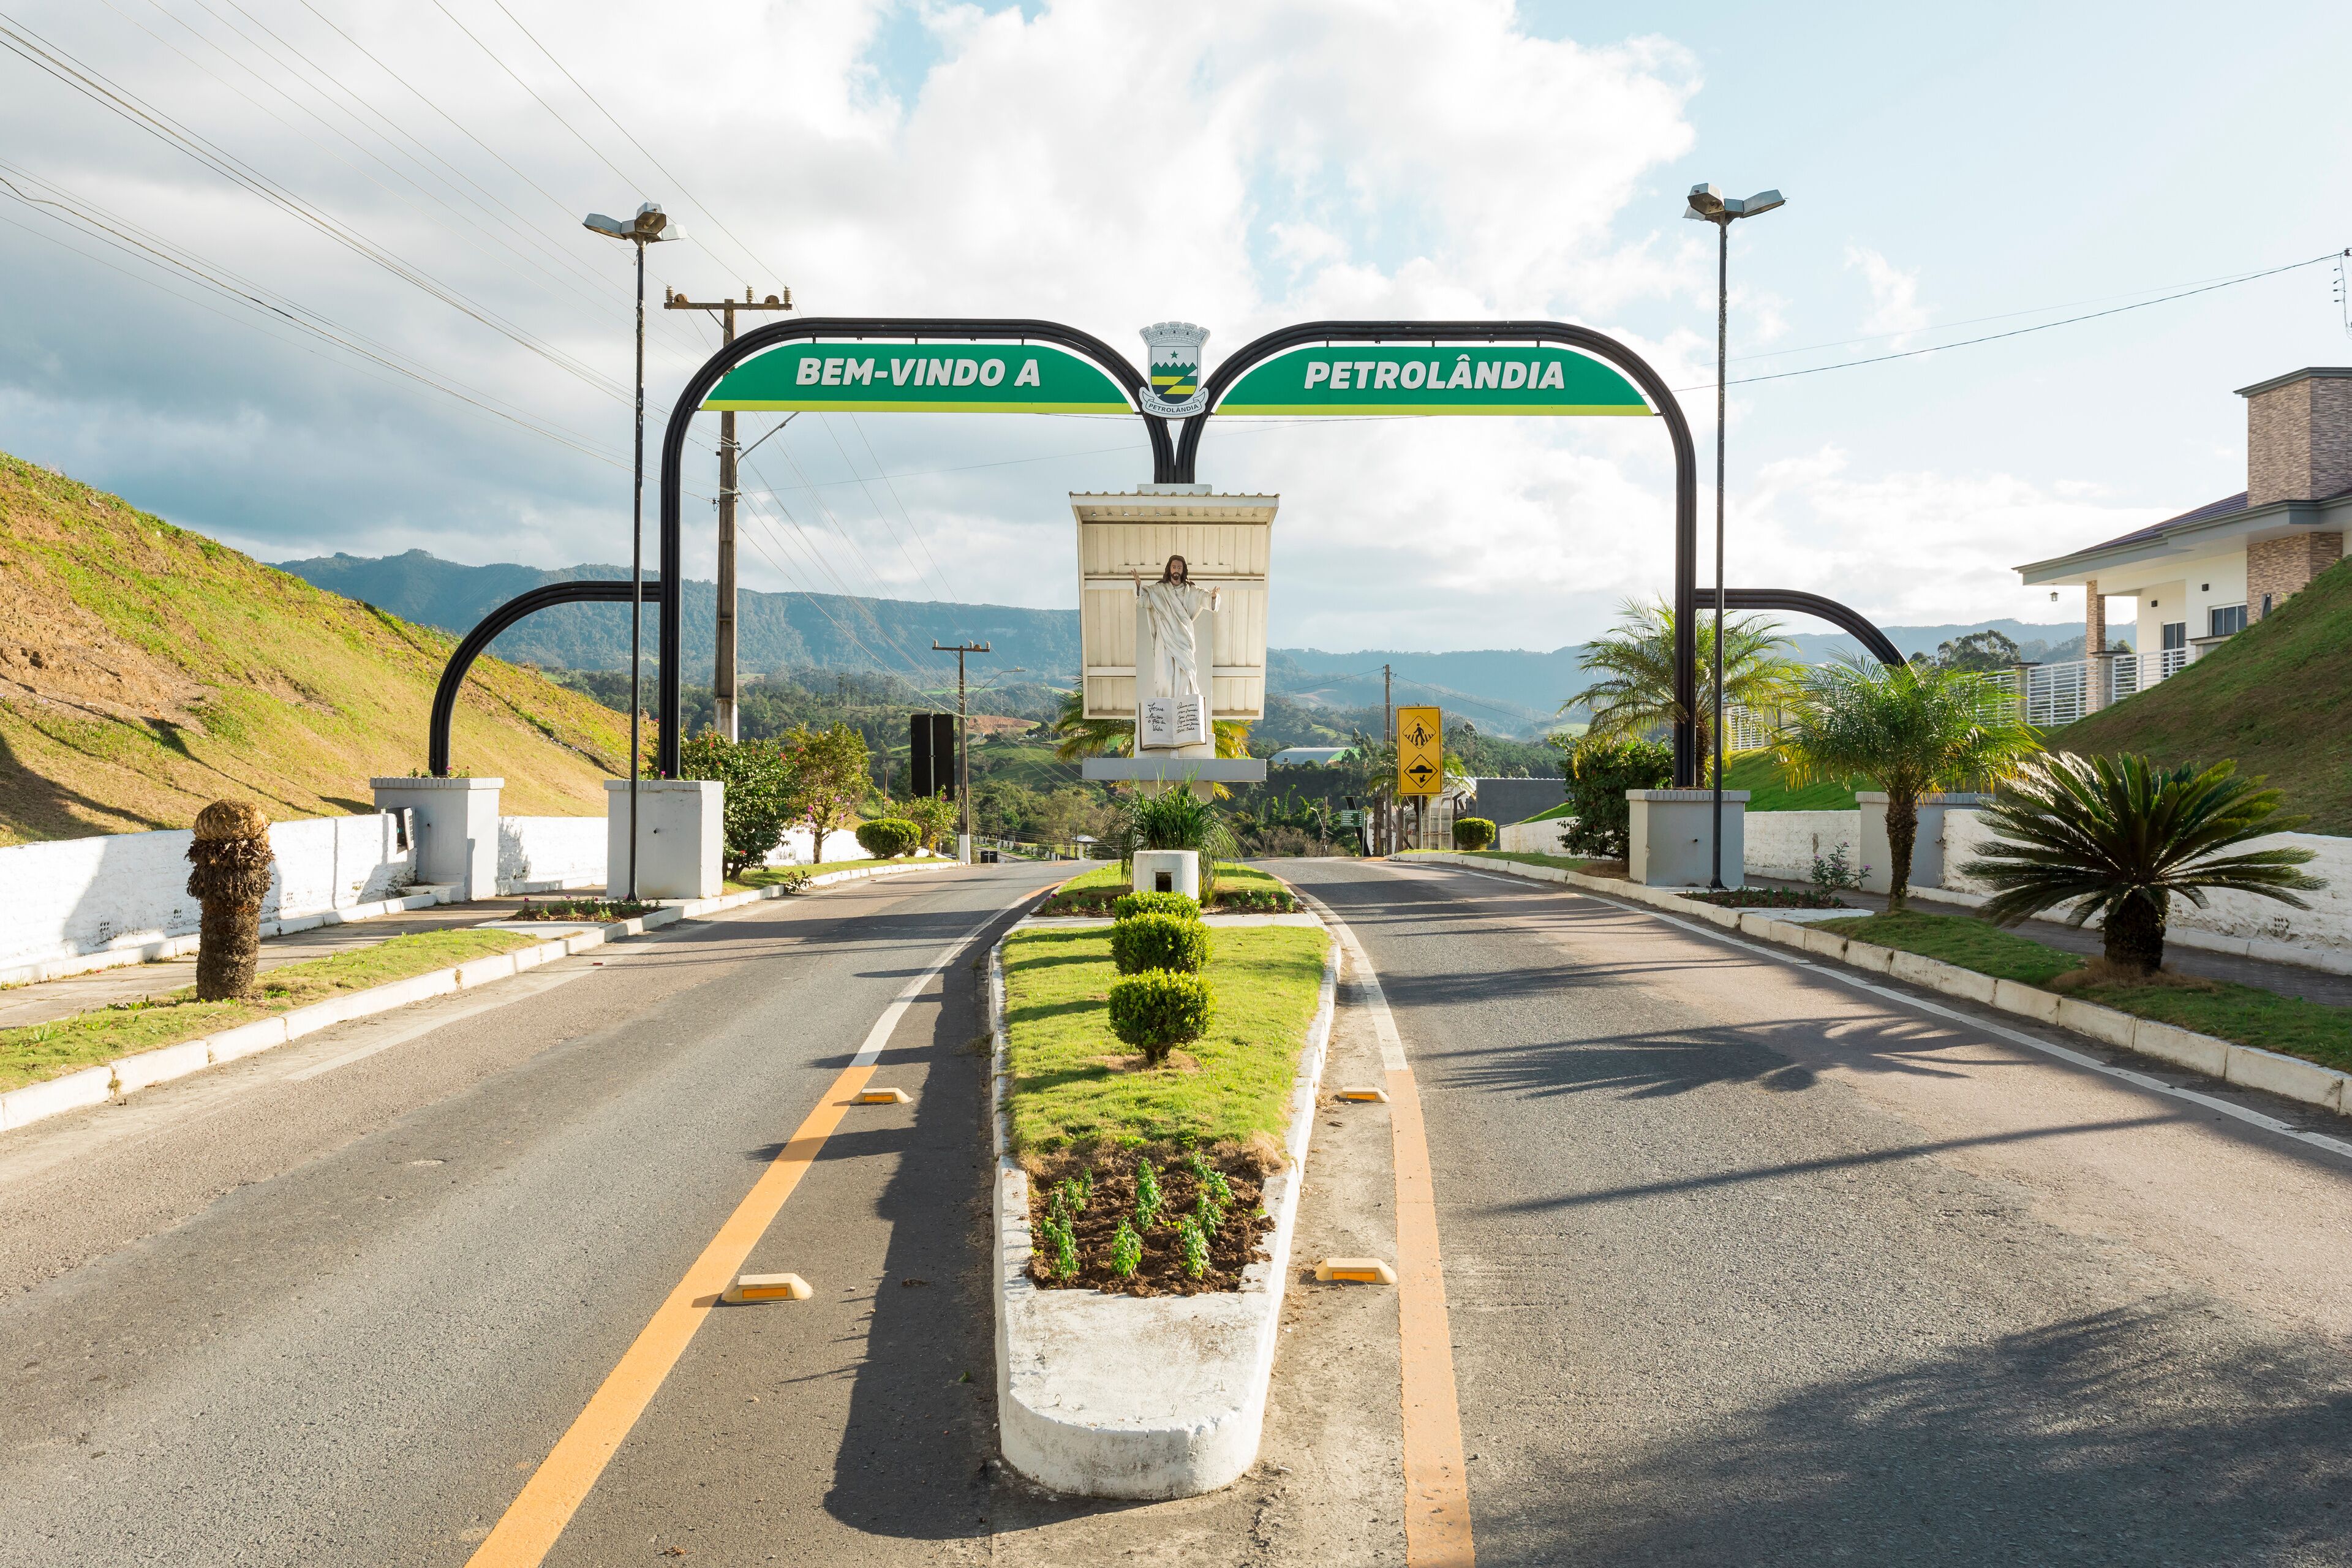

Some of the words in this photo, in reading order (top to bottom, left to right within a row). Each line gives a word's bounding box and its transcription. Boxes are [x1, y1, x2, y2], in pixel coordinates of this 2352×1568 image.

[796, 358, 1006, 386] BEM-VINDO
[1014, 359, 1040, 387] A
[1303, 353, 1565, 390] PETROLÂNDIA
[1148, 403, 1199, 413] PETROLÂNDIA
